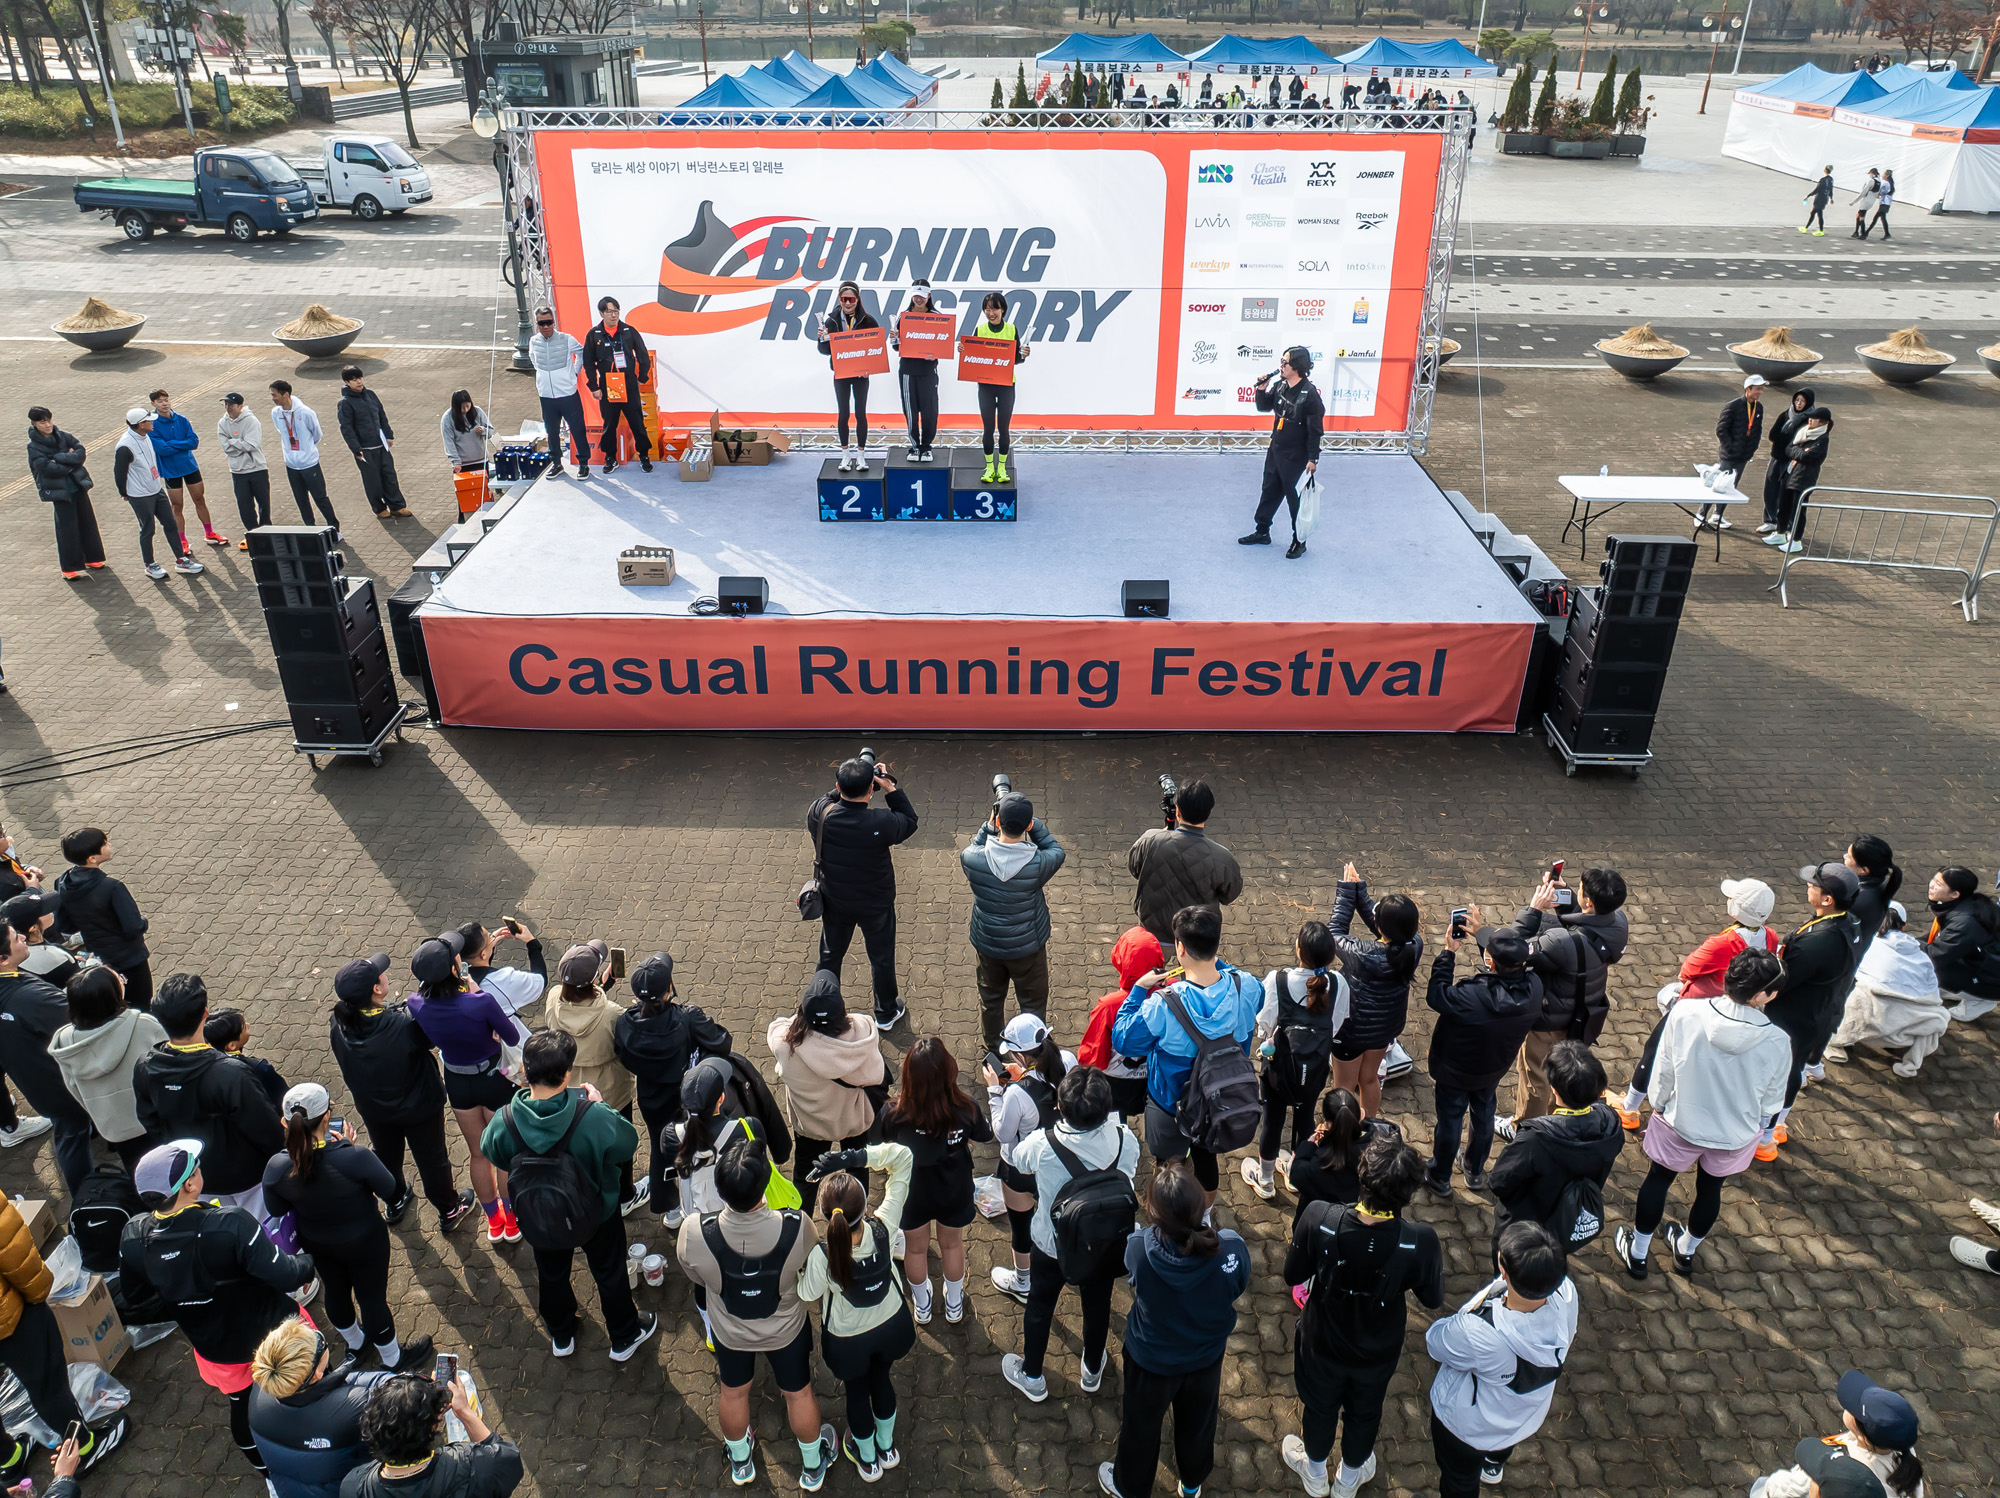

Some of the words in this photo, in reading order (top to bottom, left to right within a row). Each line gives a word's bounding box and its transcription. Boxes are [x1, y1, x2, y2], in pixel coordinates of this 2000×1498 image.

[528, 43, 558, 54] 안내소
[1062, 63, 1071, 72] A
[1085, 63, 1143, 73] 물품보관소
[1156, 64, 1164, 72] B
[1217, 64, 1225, 74] C
[1239, 65, 1296, 75] 물품보관소
[1310, 66, 1318, 75] D
[1371, 67, 1379, 76] E
[1393, 67, 1450, 78] 물품보관소
[1464, 69, 1472, 78] F
[591, 161, 623, 175] 달리는
[625, 161, 646, 175] 세상
[649, 161, 680, 174] 이야기
[686, 161, 749, 174] 버닝런스토리
[752, 161, 784, 174] 일레븐
[1254, 162, 1286, 174] Choco
[1251, 172, 1287, 186] Health
[1356, 171, 1395, 179] JOHNBER
[1307, 179, 1337, 187] REXY
[1246, 213, 1271, 221] GREEN
[1355, 212, 1389, 220] Reebok
[1251, 220, 1286, 228] MONSTER
[756, 226, 1056, 283] BURNING
[1295, 299, 1326, 307] GOOD
[1188, 304, 1226, 313] SOYJOY
[1244, 308, 1275, 320] 동원샘물
[905, 331, 936, 340] Woman
[936, 333, 950, 341] 1st
[1194, 340, 1216, 352] Run
[836, 350, 866, 360] Woman
[867, 346, 883, 356] 2nd
[1192, 351, 1218, 364] Story
[1348, 350, 1376, 358] Jamful
[963, 355, 994, 365] Woman
[994, 358, 1010, 366] 3rd
[910, 480, 923, 507] 1
[841, 485, 862, 513] 2
[975, 492, 994, 518] 3
[509, 644, 769, 696] Casual
[799, 646, 1120, 708] Running
[1151, 646, 1448, 697] Festival
